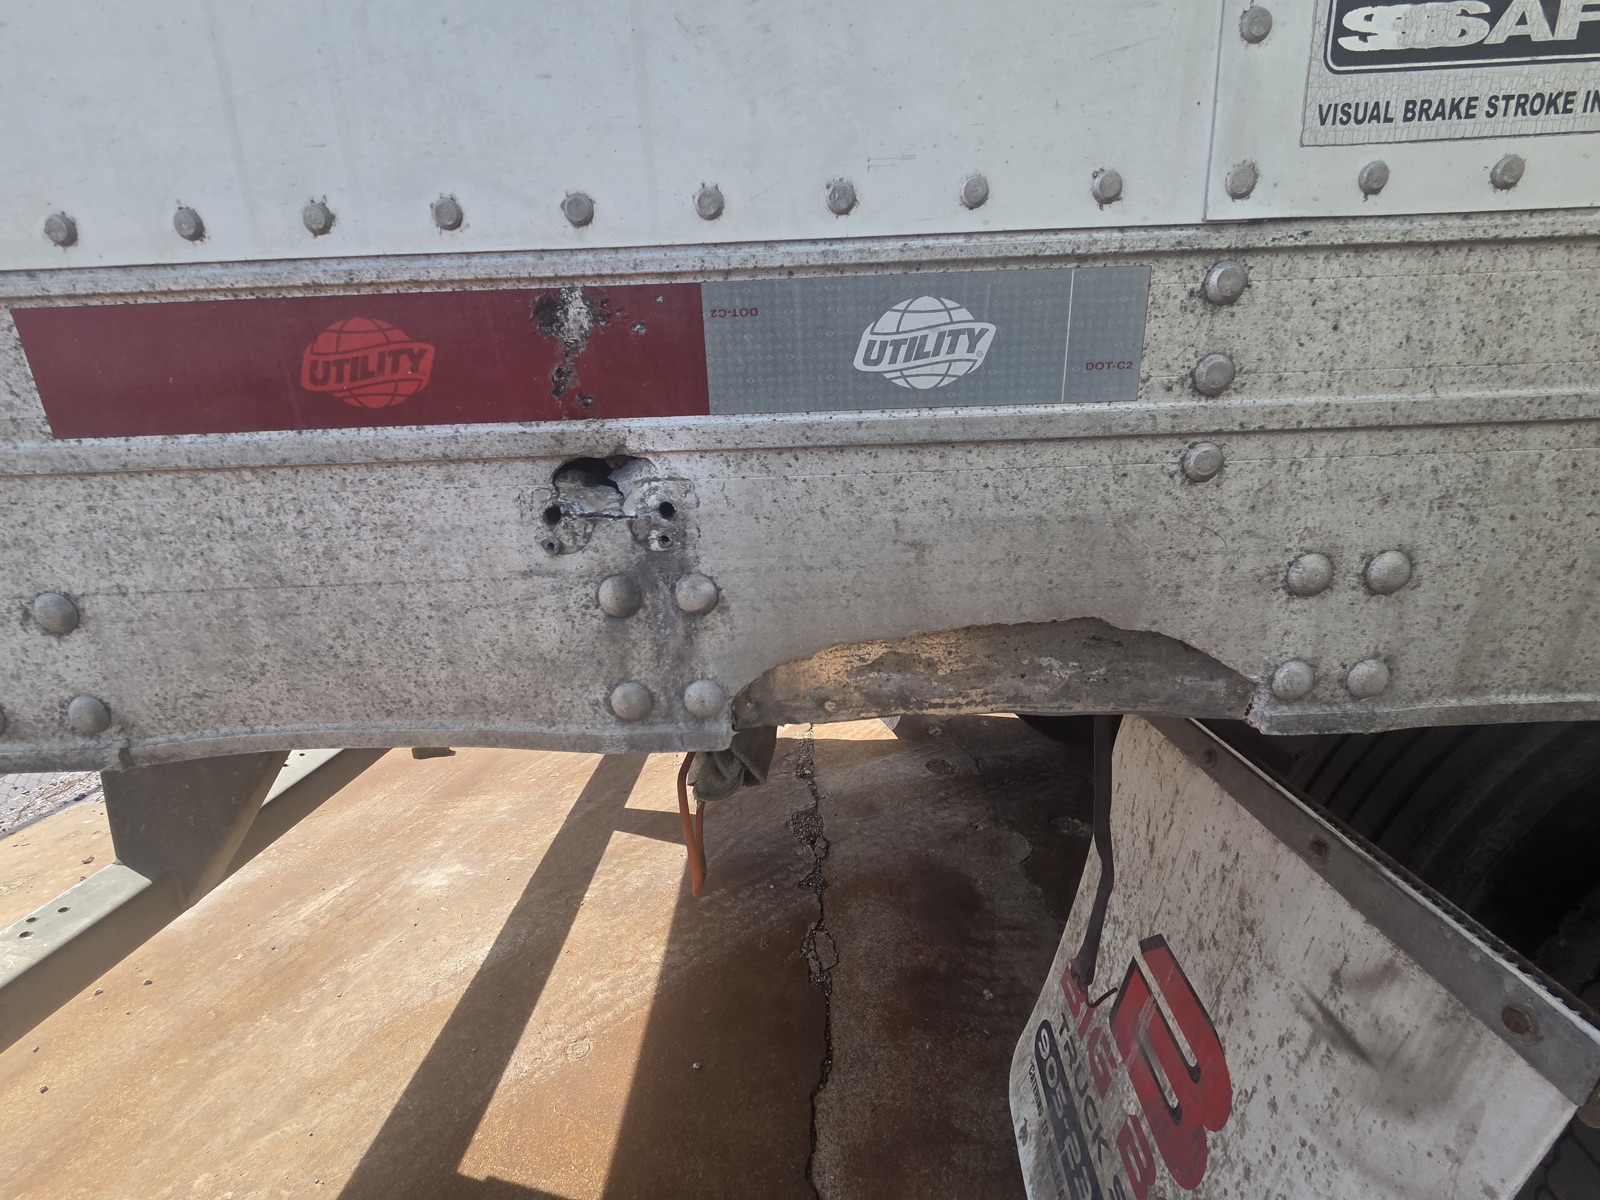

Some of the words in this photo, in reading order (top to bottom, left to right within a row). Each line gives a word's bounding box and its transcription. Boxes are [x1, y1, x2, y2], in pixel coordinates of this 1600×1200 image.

[1318, 101, 1394, 126] VISUAL
[1402, 96, 1479, 123] BRAKE
[1485, 91, 1577, 118] STROKE
[710, 307, 758, 318] DOT-C2
[310, 347, 428, 387] UTILITY
[862, 327, 990, 367] UTILITY
[1085, 361, 1133, 371] DOT-C2
[1028, 1065, 1045, 1117] CATERING
[1059, 1012, 1110, 1167] TRUCK
[1115, 1114, 1166, 1200] B
